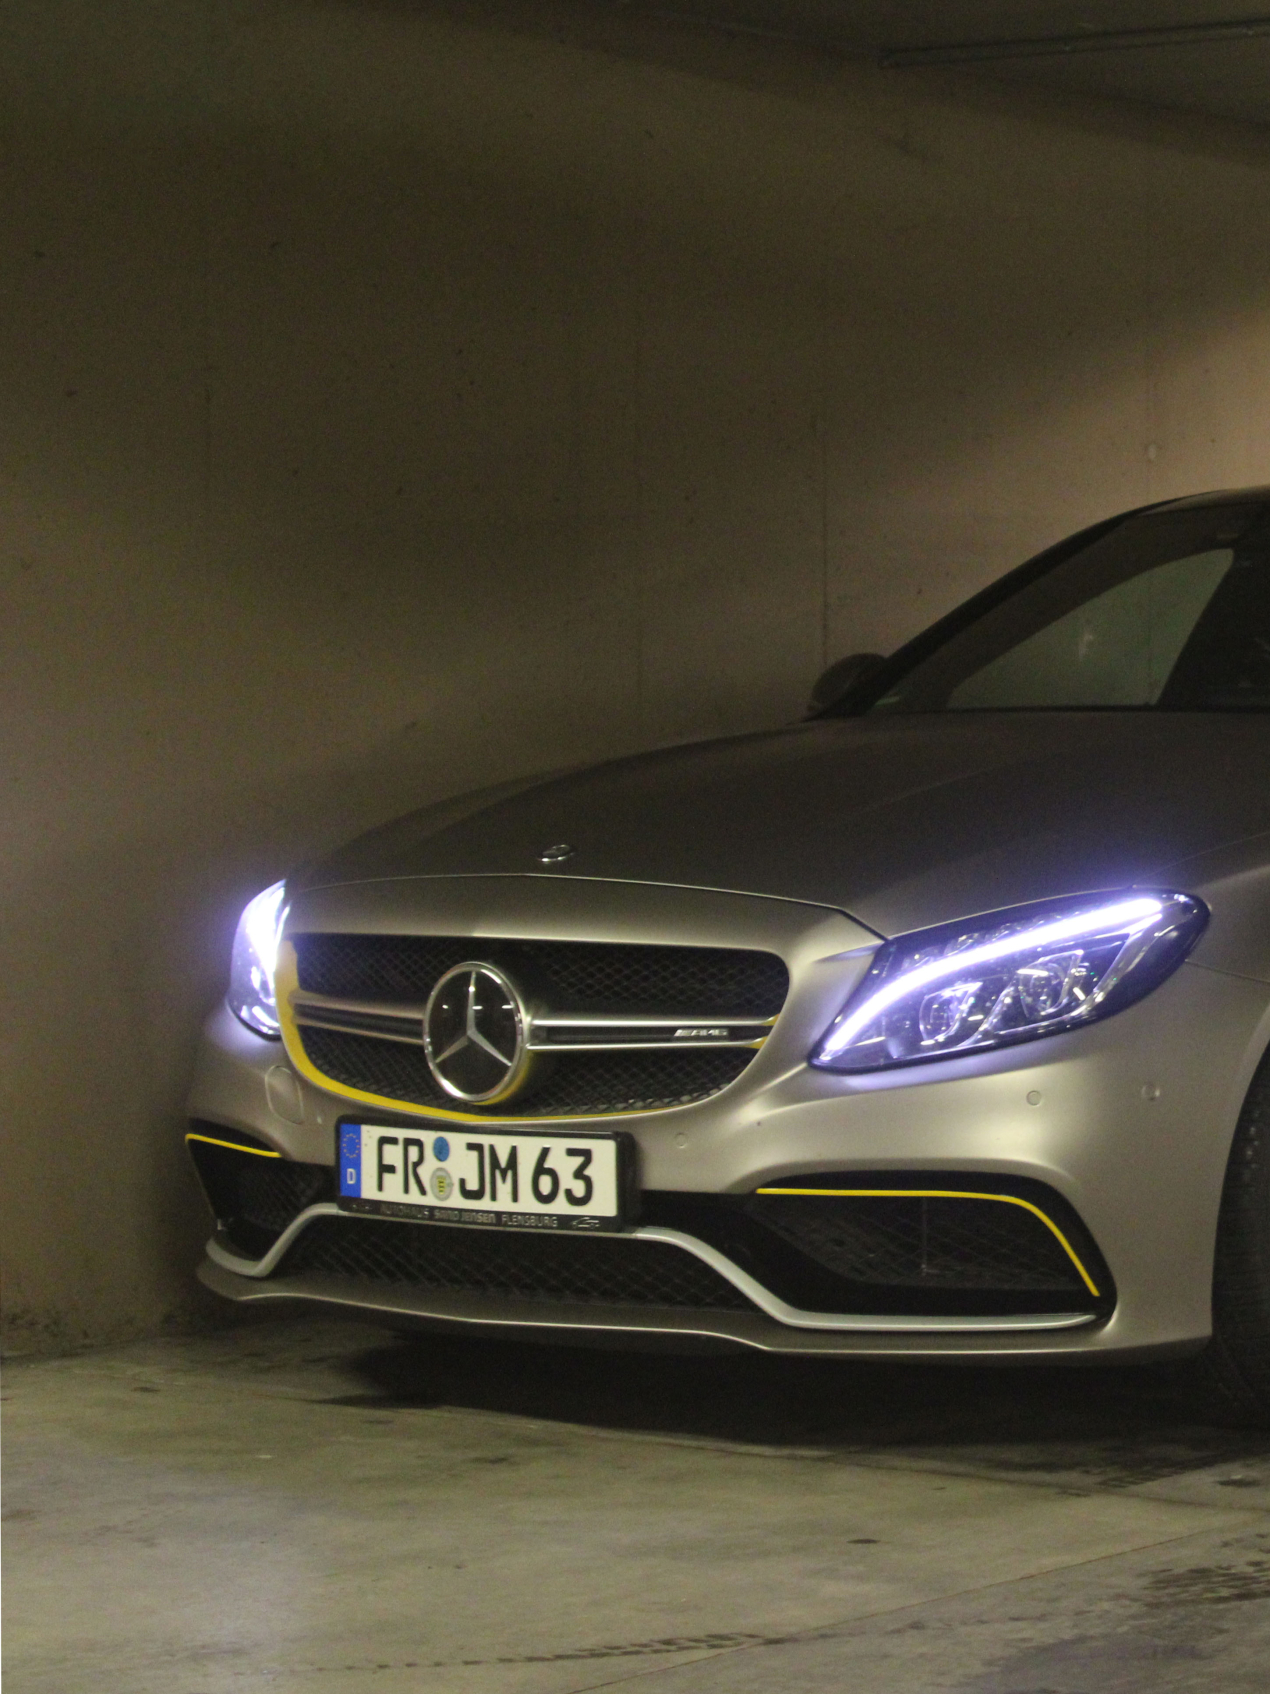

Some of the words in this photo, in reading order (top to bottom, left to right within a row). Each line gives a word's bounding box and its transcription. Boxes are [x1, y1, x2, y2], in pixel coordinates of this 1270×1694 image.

[346, 1168, 356, 1185] D
[377, 1135, 427, 1196] FR
[459, 1142, 519, 1203] JM
[532, 1146, 593, 1207] 63
